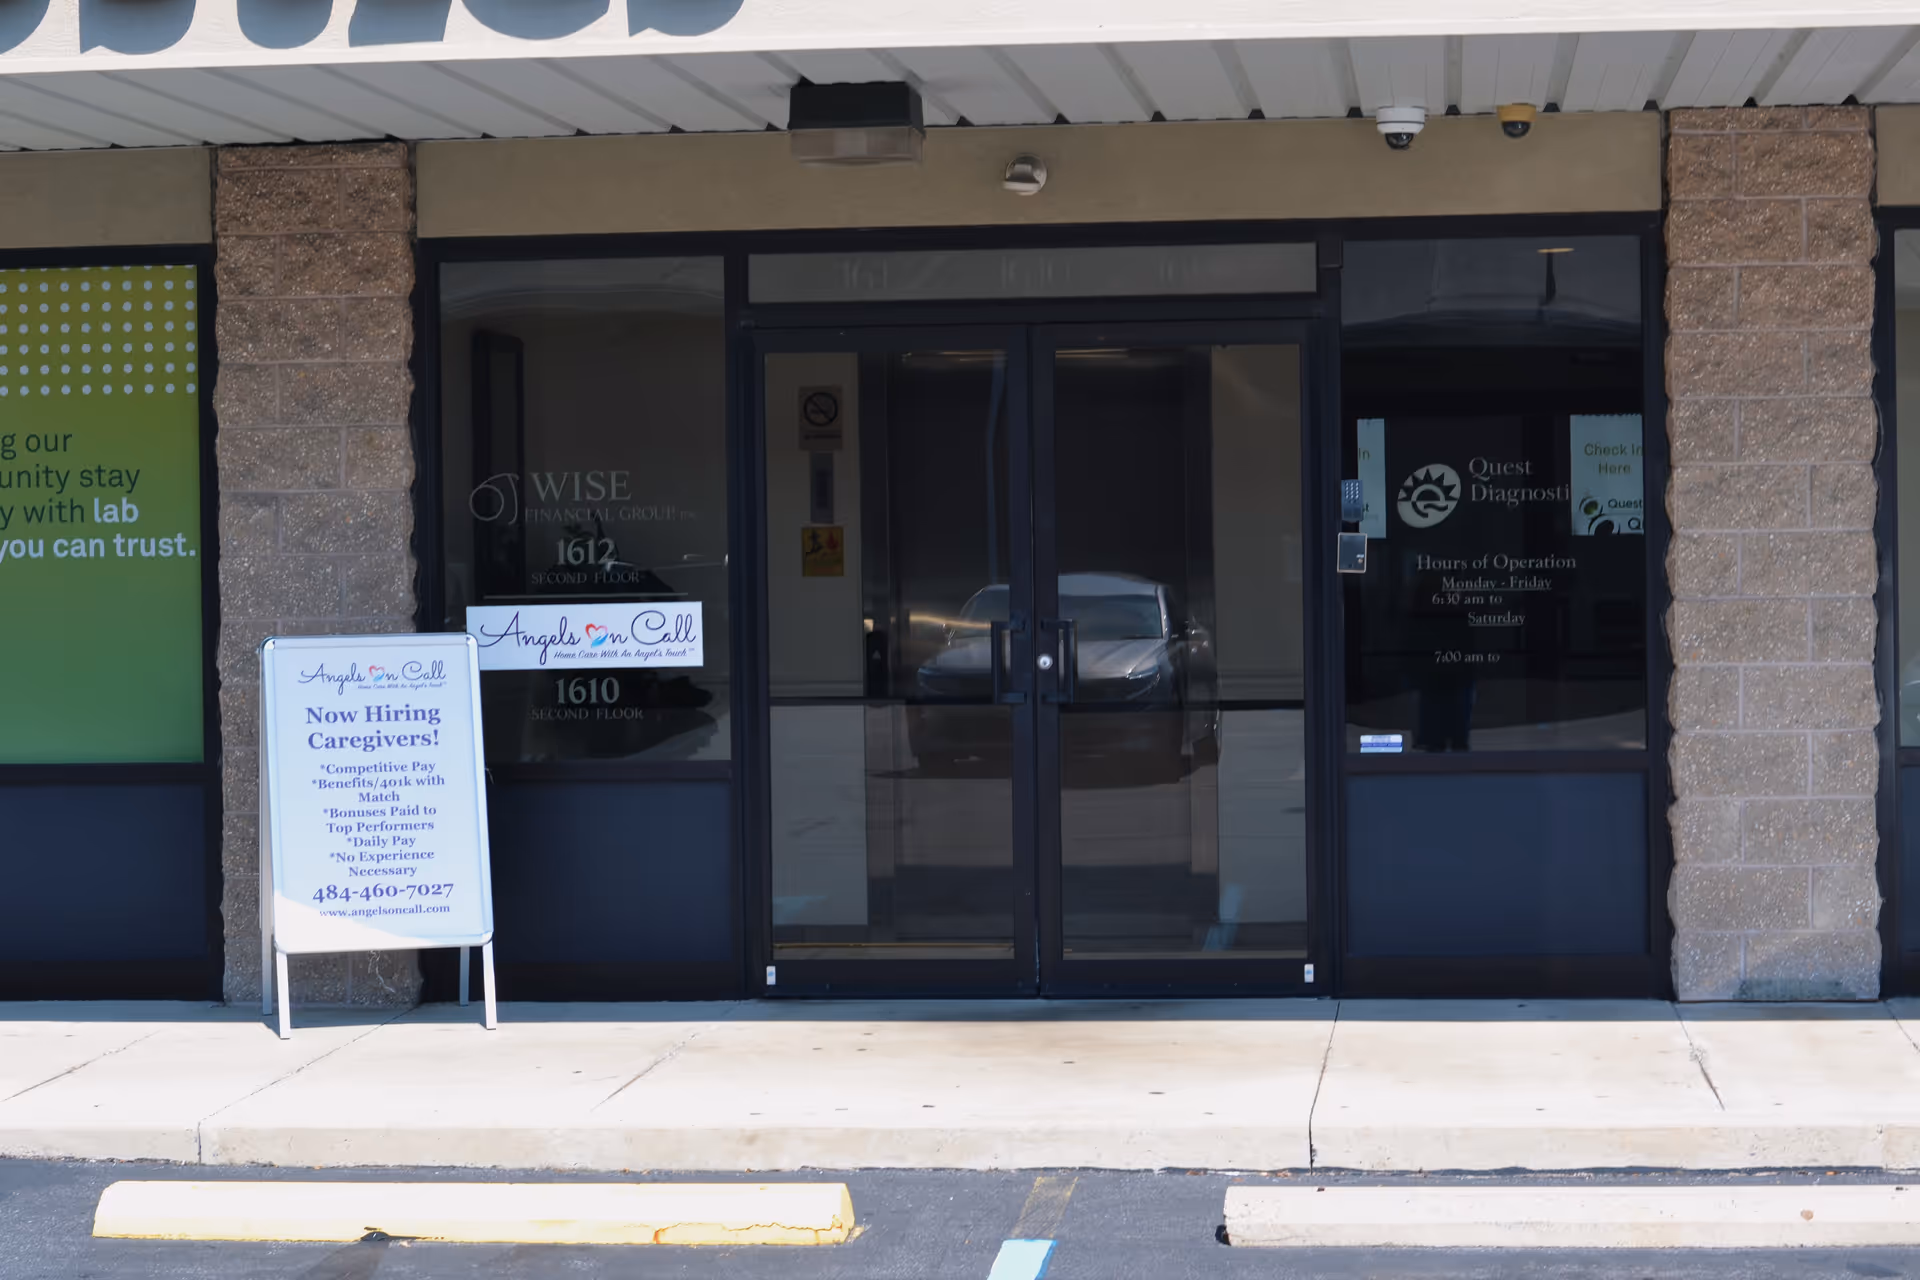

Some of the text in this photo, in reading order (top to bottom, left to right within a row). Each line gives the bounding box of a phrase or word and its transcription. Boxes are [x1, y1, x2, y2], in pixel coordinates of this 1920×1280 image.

[25, 433, 72, 452] our
[1584, 443, 1628, 456] Check
[1468, 457, 1534, 481] Quest
[1598, 462, 1631, 474] Here
[80, 465, 140, 494] stay
[530, 470, 632, 501] WISE
[24, 499, 84, 523] with
[94, 497, 139, 523] lab
[1608, 498, 1642, 509] Quest
[525, 507, 615, 523] FINANCIAL
[53, 538, 105, 557] can
[113, 533, 196, 557] trust.
[556, 538, 616, 565] 1612
[1417, 554, 1577, 572] Hours of Operation
[531, 570, 641, 585] SECOND FLOOR
[1442, 576, 1496, 590] Monday
[1510, 575, 1551, 590] Friday
[1432, 593, 1503, 605] 6:30 am to
[1468, 611, 1525, 626] Saturday
[477, 611, 581, 665] Angels
[630, 610, 697, 645] Call
[554, 650, 577, 659] Home
[578, 650, 598, 658] Care
[600, 649, 619, 658] With
[621, 649, 632, 658] An
[1435, 651, 1500, 662] 7:00 am to
[297, 662, 366, 696] Angels
[401, 660, 447, 681] Call
[556, 677, 620, 704] 1610
[305, 703, 441, 726] Now Hiring
[531, 707, 644, 720] SECOND FLOOR
[308, 729, 439, 752] Caregivers!
[412, 761, 436, 774] Pay
[415, 775, 445, 786] with
[358, 790, 400, 802] Match
[390, 805, 420, 817] Paid
[423, 806, 437, 816] to
[326, 820, 434, 836] Top Performers
[392, 835, 416, 847] Pay
[359, 849, 435, 864] Experience
[348, 866, 417, 877] Necessary
[312, 883, 454, 904] 484-460-7027
[319, 904, 450, 918] www.angelsoncall.com
